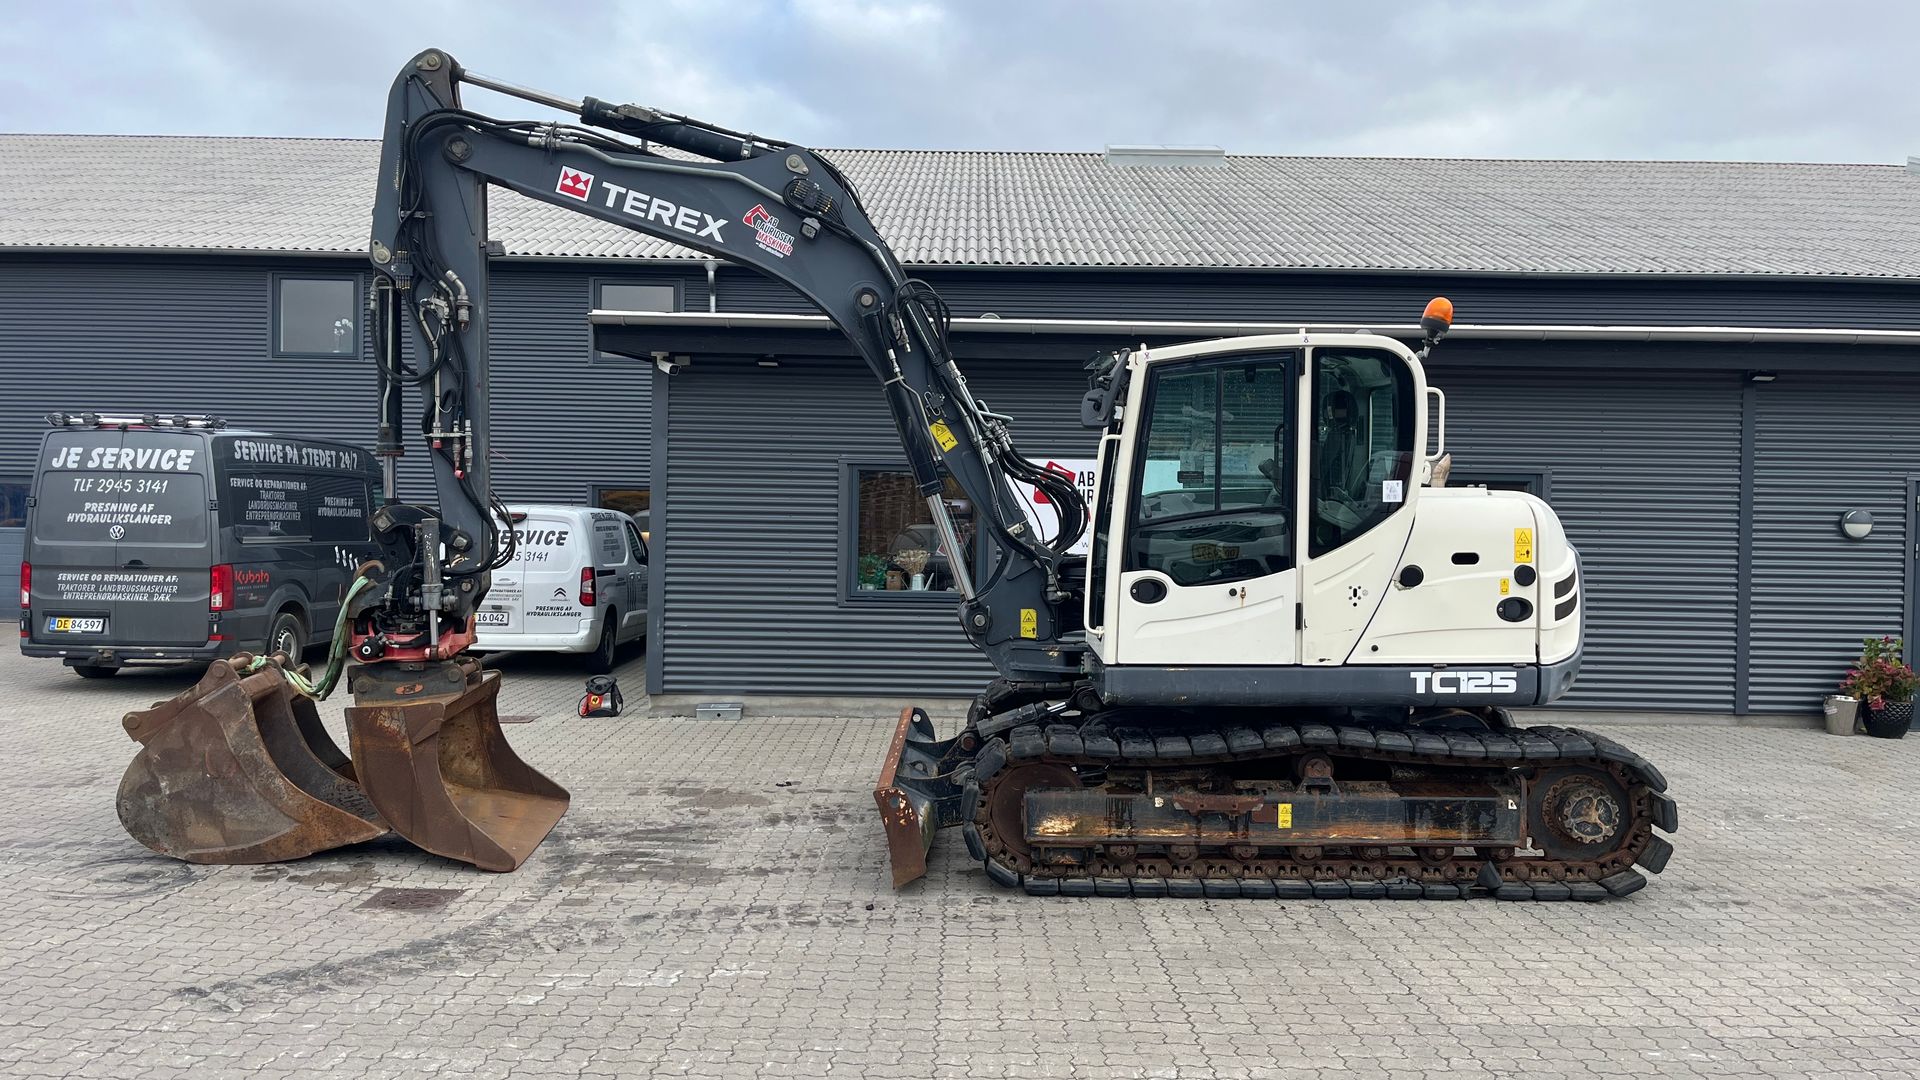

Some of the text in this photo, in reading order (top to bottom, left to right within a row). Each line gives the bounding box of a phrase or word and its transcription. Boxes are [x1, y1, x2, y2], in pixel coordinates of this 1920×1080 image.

[601, 181, 729, 243] TEREX
[768, 215, 779, 227] AB
[755, 220, 795, 245] LAURIDSEN
[755, 230, 793, 256] MASKINER
[51, 447, 195, 470] JE SERVICE
[234, 440, 358, 470] SERVICE PÅ STEDET 24/7
[230, 478, 253, 487] SERVICE
[1077, 471, 1095, 486] AB
[73, 479, 168, 493] TLF 2945 3141
[84, 502, 154, 513] PRESNING AF
[67, 513, 172, 525] HYDRAULIKSLANGER
[497, 530, 568, 546] ERVICE
[525, 552, 548, 561] 3141
[103, 574, 164, 582] REPARATIONER
[235, 569, 270, 584] Kubota
[57, 584, 178, 593] TRAKTORER LANDBRUGSMASKINER
[63, 592, 148, 601] ENTREPRENØRMASKINER
[56, 619, 68, 629] DE
[489, 614, 505, 622] 042
[1410, 671, 1518, 694] TC125
